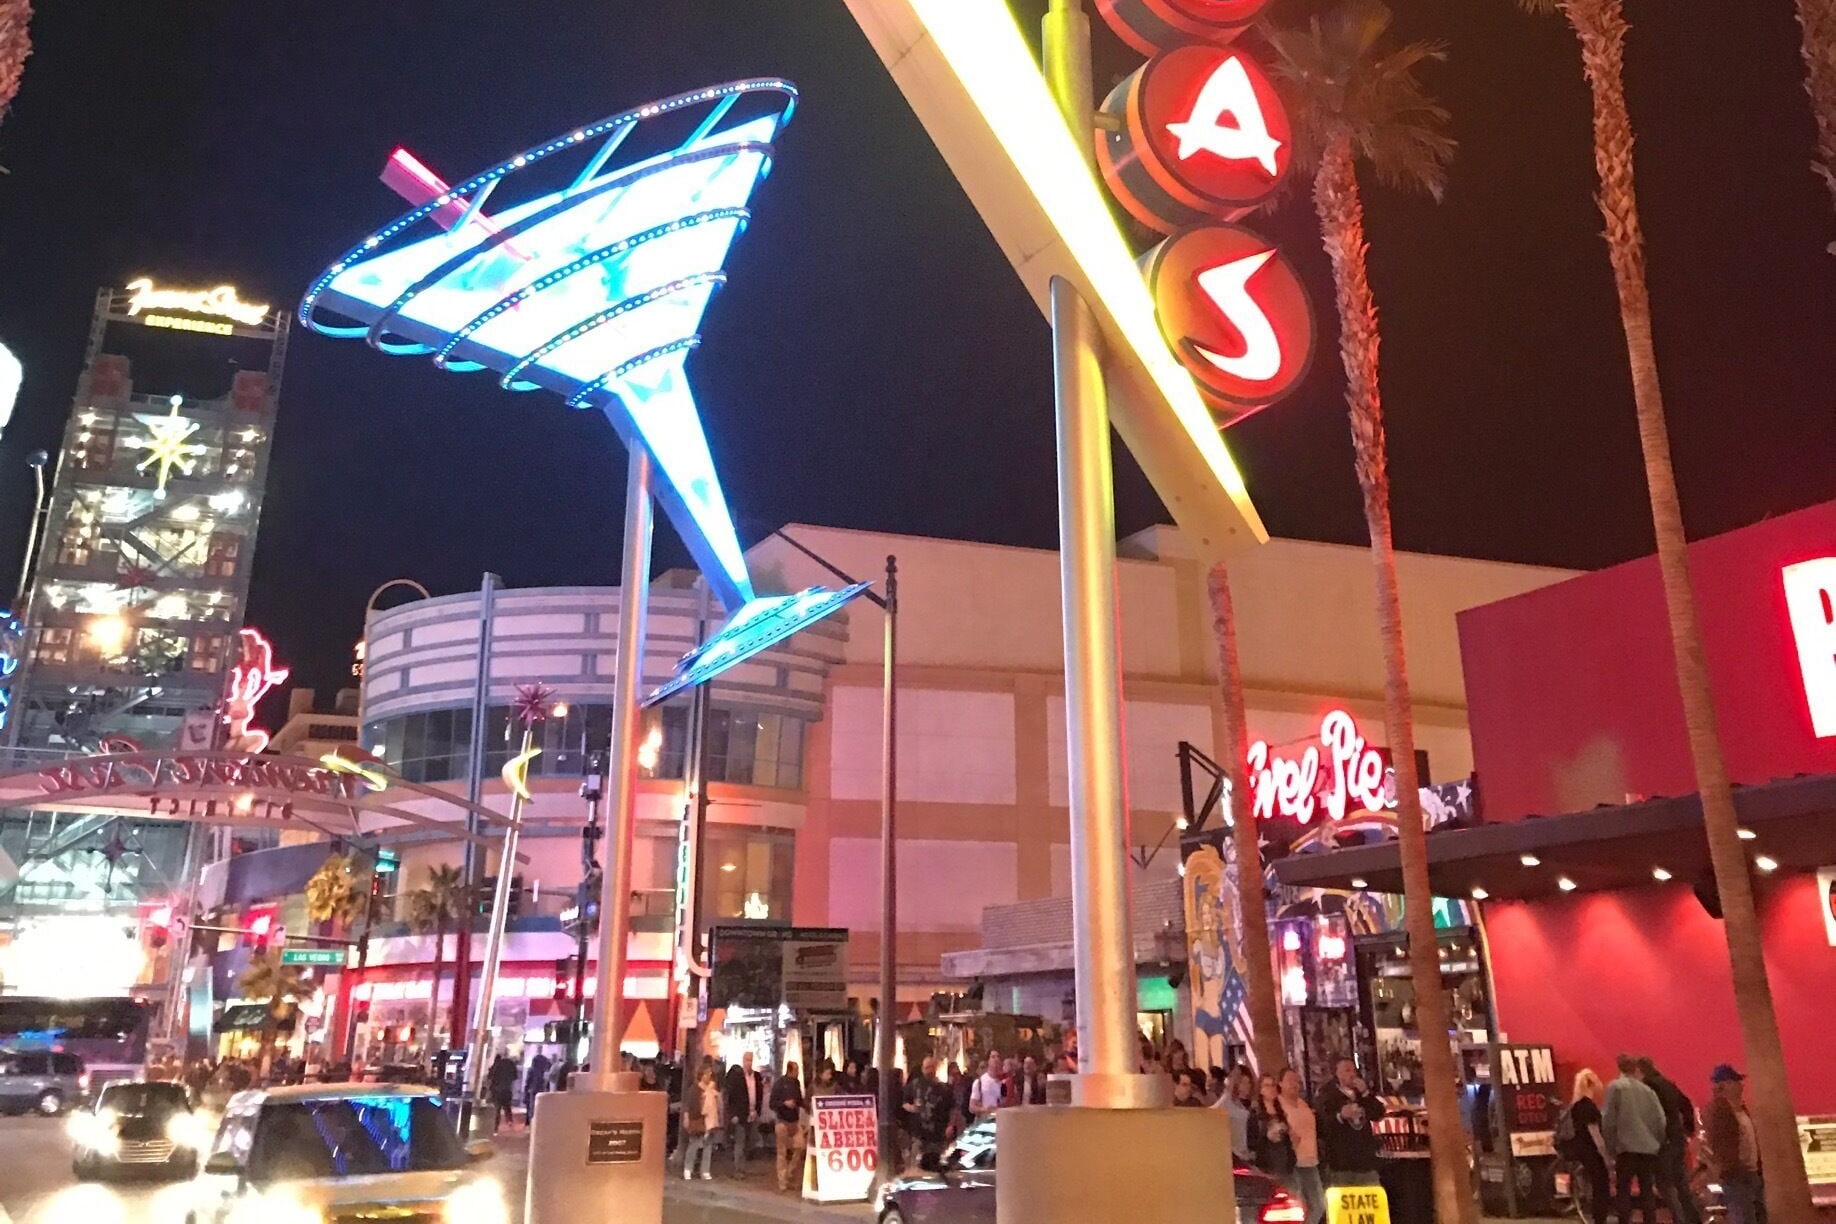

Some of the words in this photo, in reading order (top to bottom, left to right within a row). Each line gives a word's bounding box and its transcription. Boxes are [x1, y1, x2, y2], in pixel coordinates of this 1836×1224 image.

[1321, 709, 1385, 820] Pie
[1501, 1048, 1555, 1085] ATM
[1341, 1194, 1379, 1209] STATE
